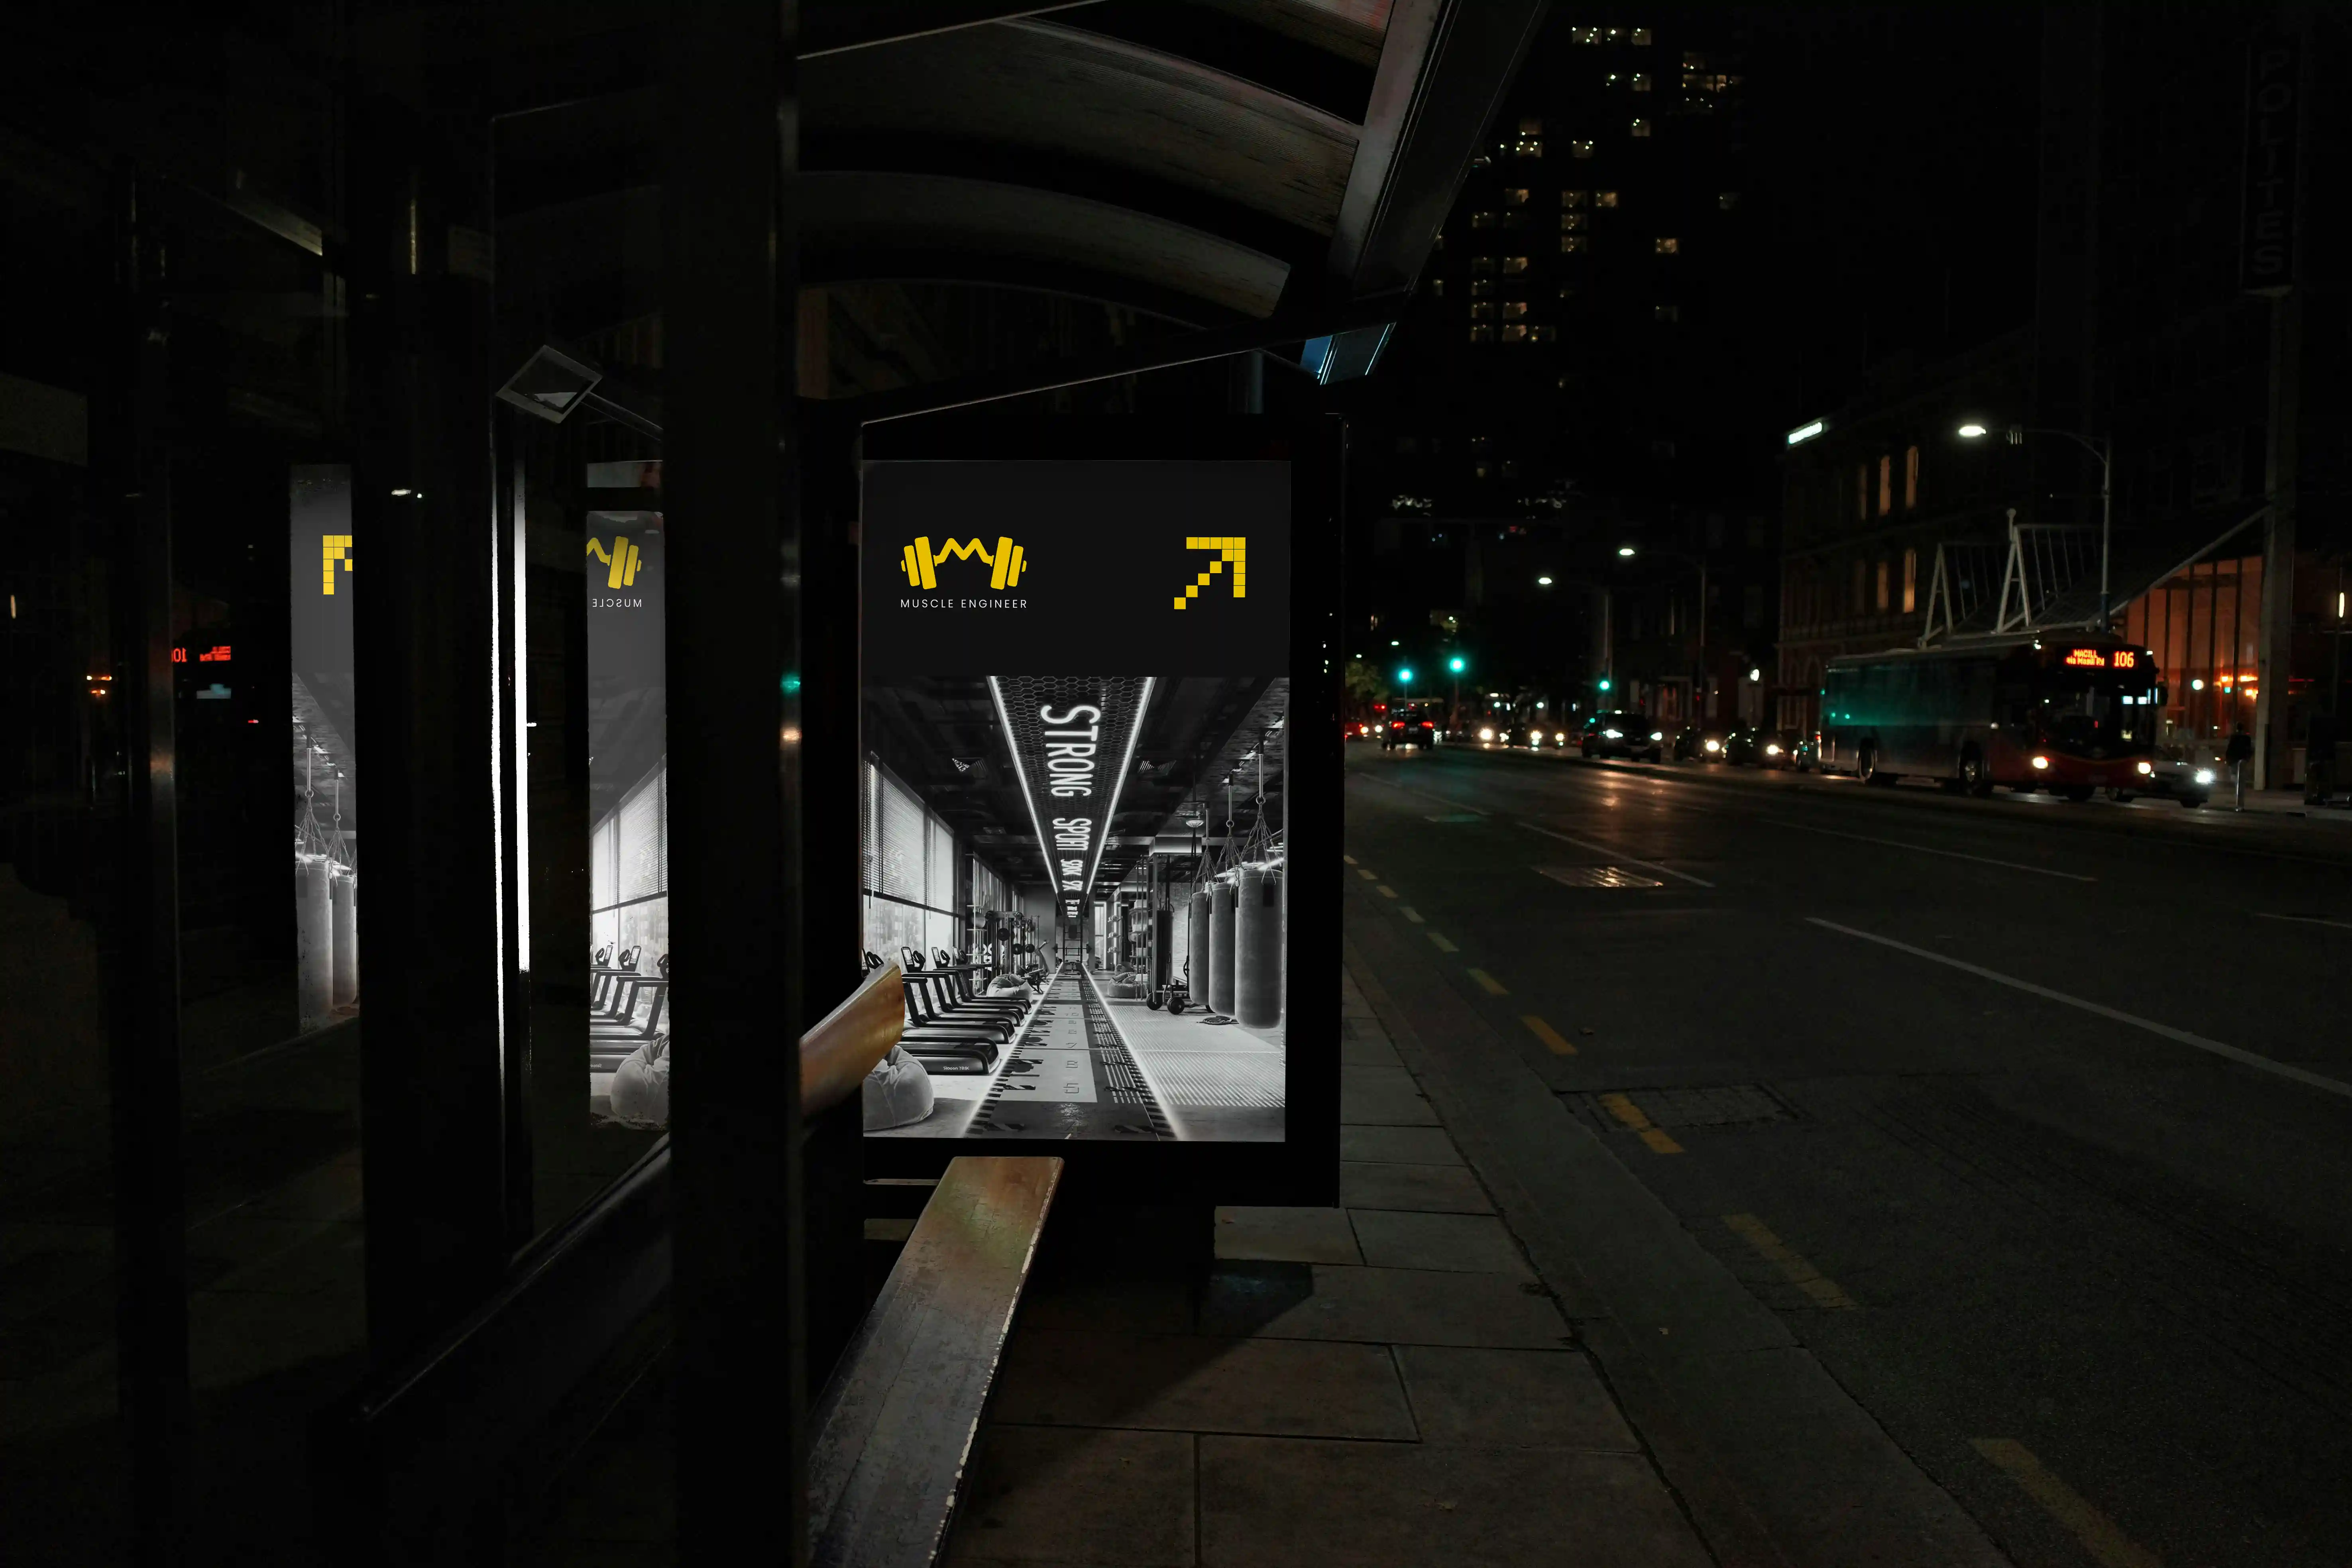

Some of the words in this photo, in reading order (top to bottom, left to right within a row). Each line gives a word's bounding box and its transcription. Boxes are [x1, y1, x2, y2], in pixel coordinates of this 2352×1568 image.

[2252, 49, 2292, 275] POLITES
[901, 599, 954, 608] MUSCLE
[961, 599, 1027, 608] ENGINEER
[2113, 651, 2135, 668] 106
[1040, 704, 1102, 797] STRONG
